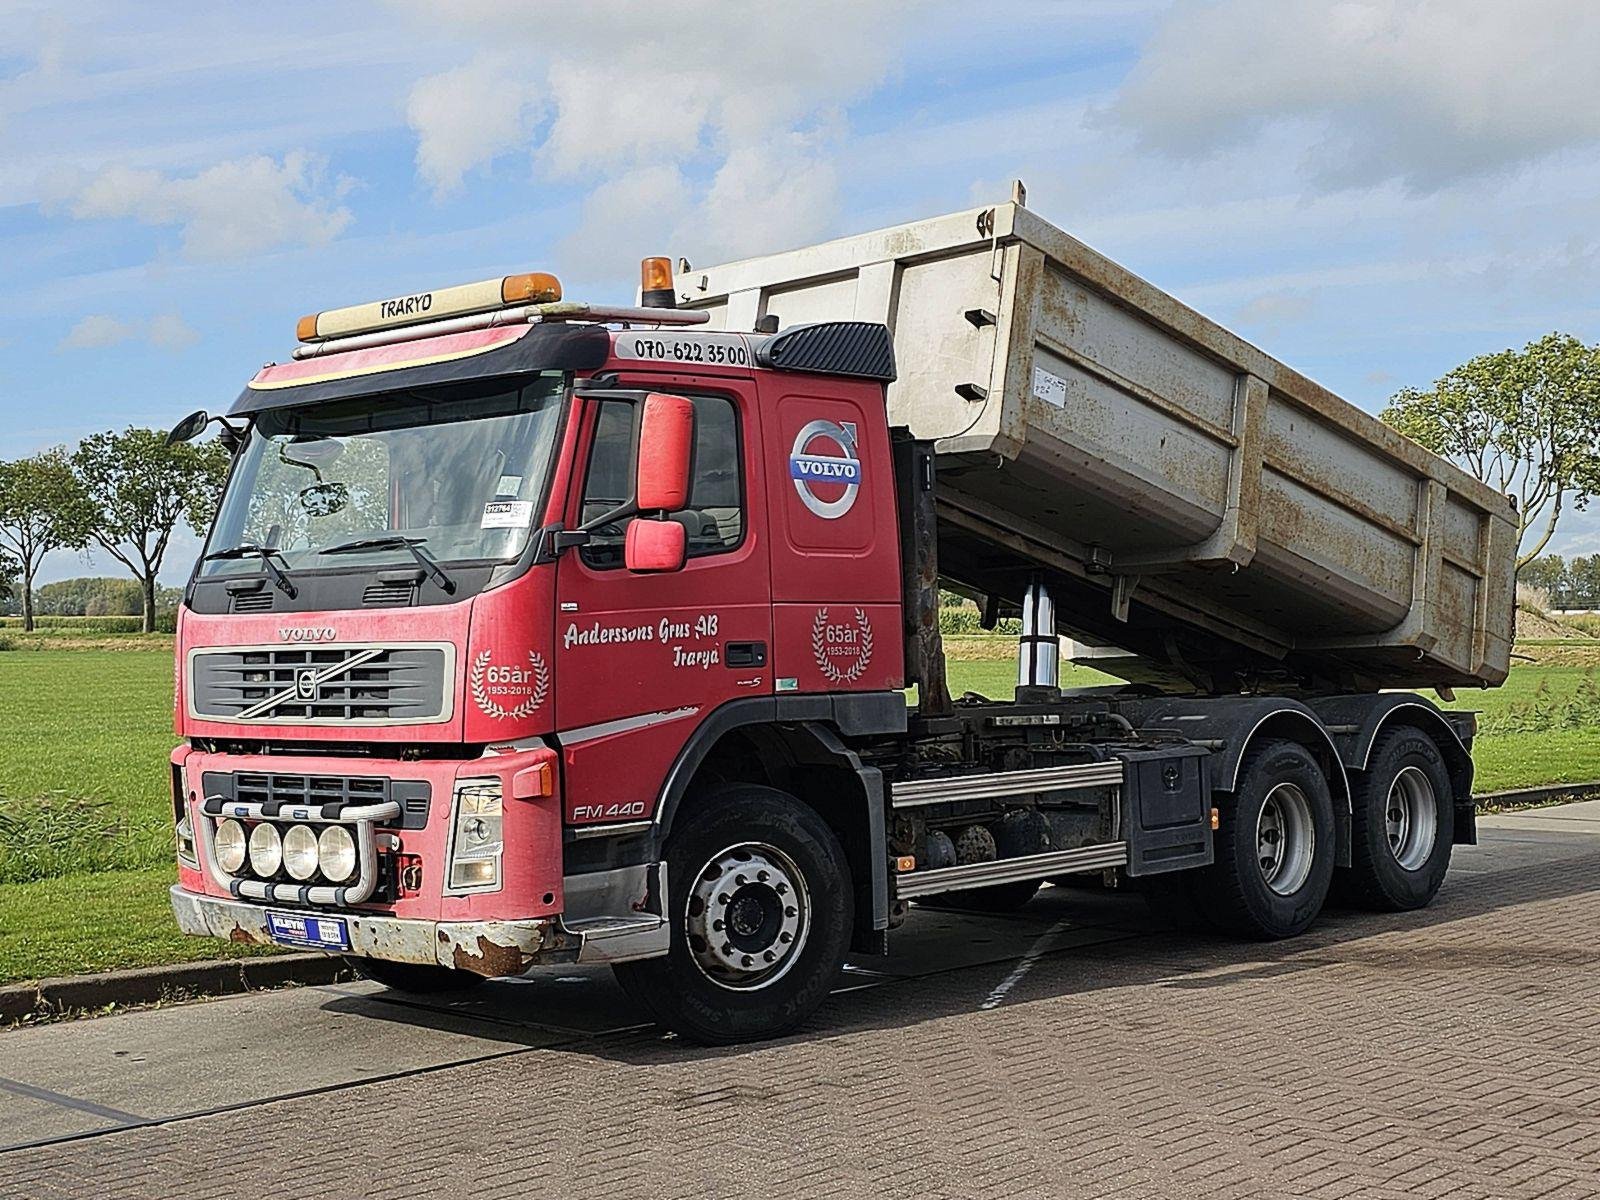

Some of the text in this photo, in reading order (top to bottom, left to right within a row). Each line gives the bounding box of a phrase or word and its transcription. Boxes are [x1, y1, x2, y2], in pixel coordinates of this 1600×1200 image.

[635, 340, 703, 362] 070-622
[796, 461, 856, 478] VOLVO
[279, 627, 336, 641] VOLVO
[563, 614, 718, 649] Anderssons Grus AB
[826, 623, 859, 643] 65år
[826, 646, 861, 655] 1953-2018
[487, 665, 532, 684] 65år
[486, 686, 532, 695] 1953-2018
[573, 802, 645, 820] FM 440
